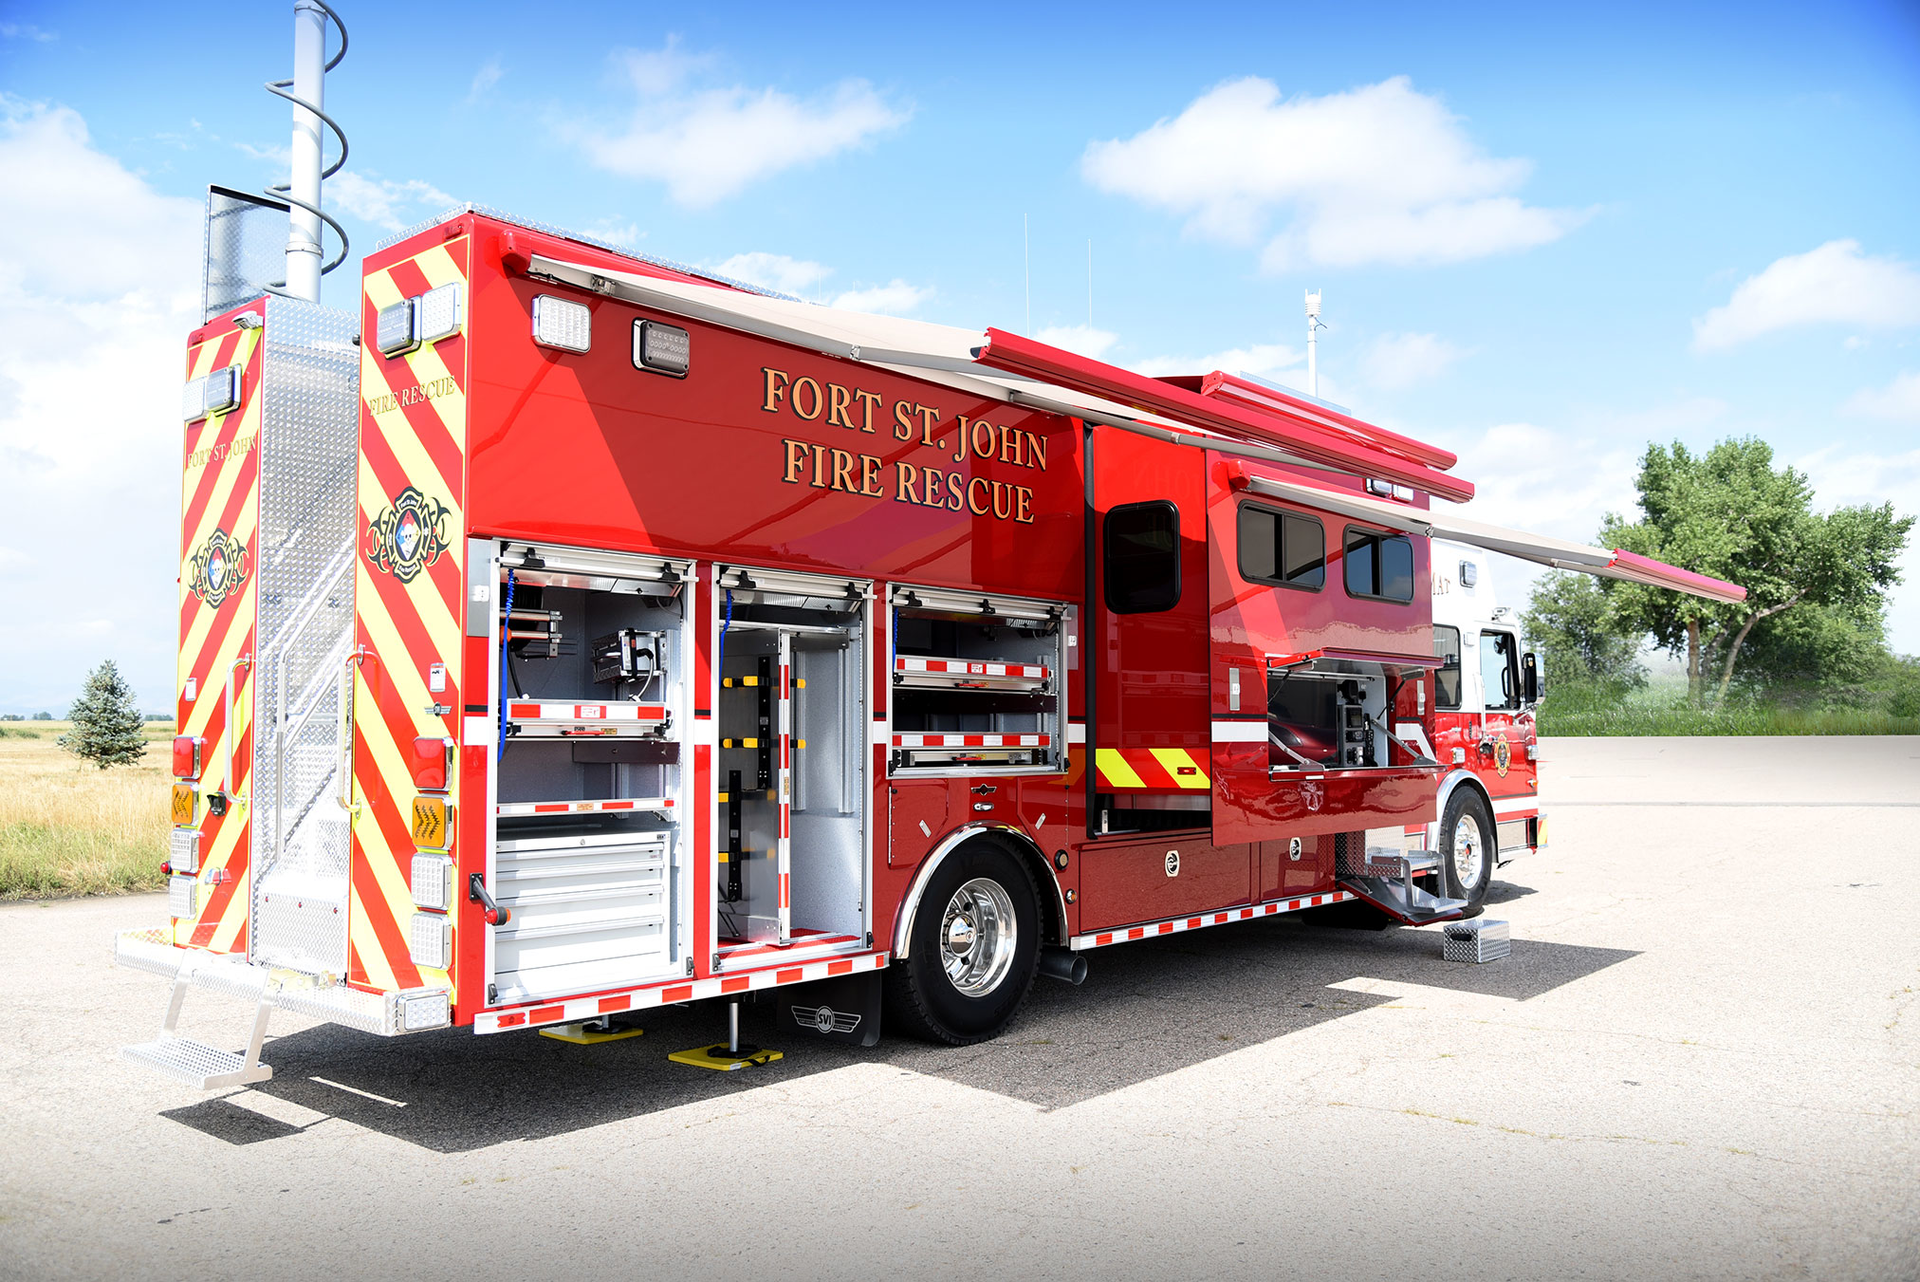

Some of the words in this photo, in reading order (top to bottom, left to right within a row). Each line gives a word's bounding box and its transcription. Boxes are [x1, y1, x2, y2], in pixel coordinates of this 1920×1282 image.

[369, 392, 398, 417] FIRE
[401, 375, 455, 407] RESCUE
[761, 366, 882, 433] FORT
[893, 400, 947, 449] ST.
[953, 415, 1048, 471] JOHN
[187, 448, 213, 469] FORT
[228, 435, 256, 461] JOHN
[782, 439, 884, 498] FIRE
[895, 461, 1035, 524] RESCUE
[818, 1013, 832, 1026] SVI
